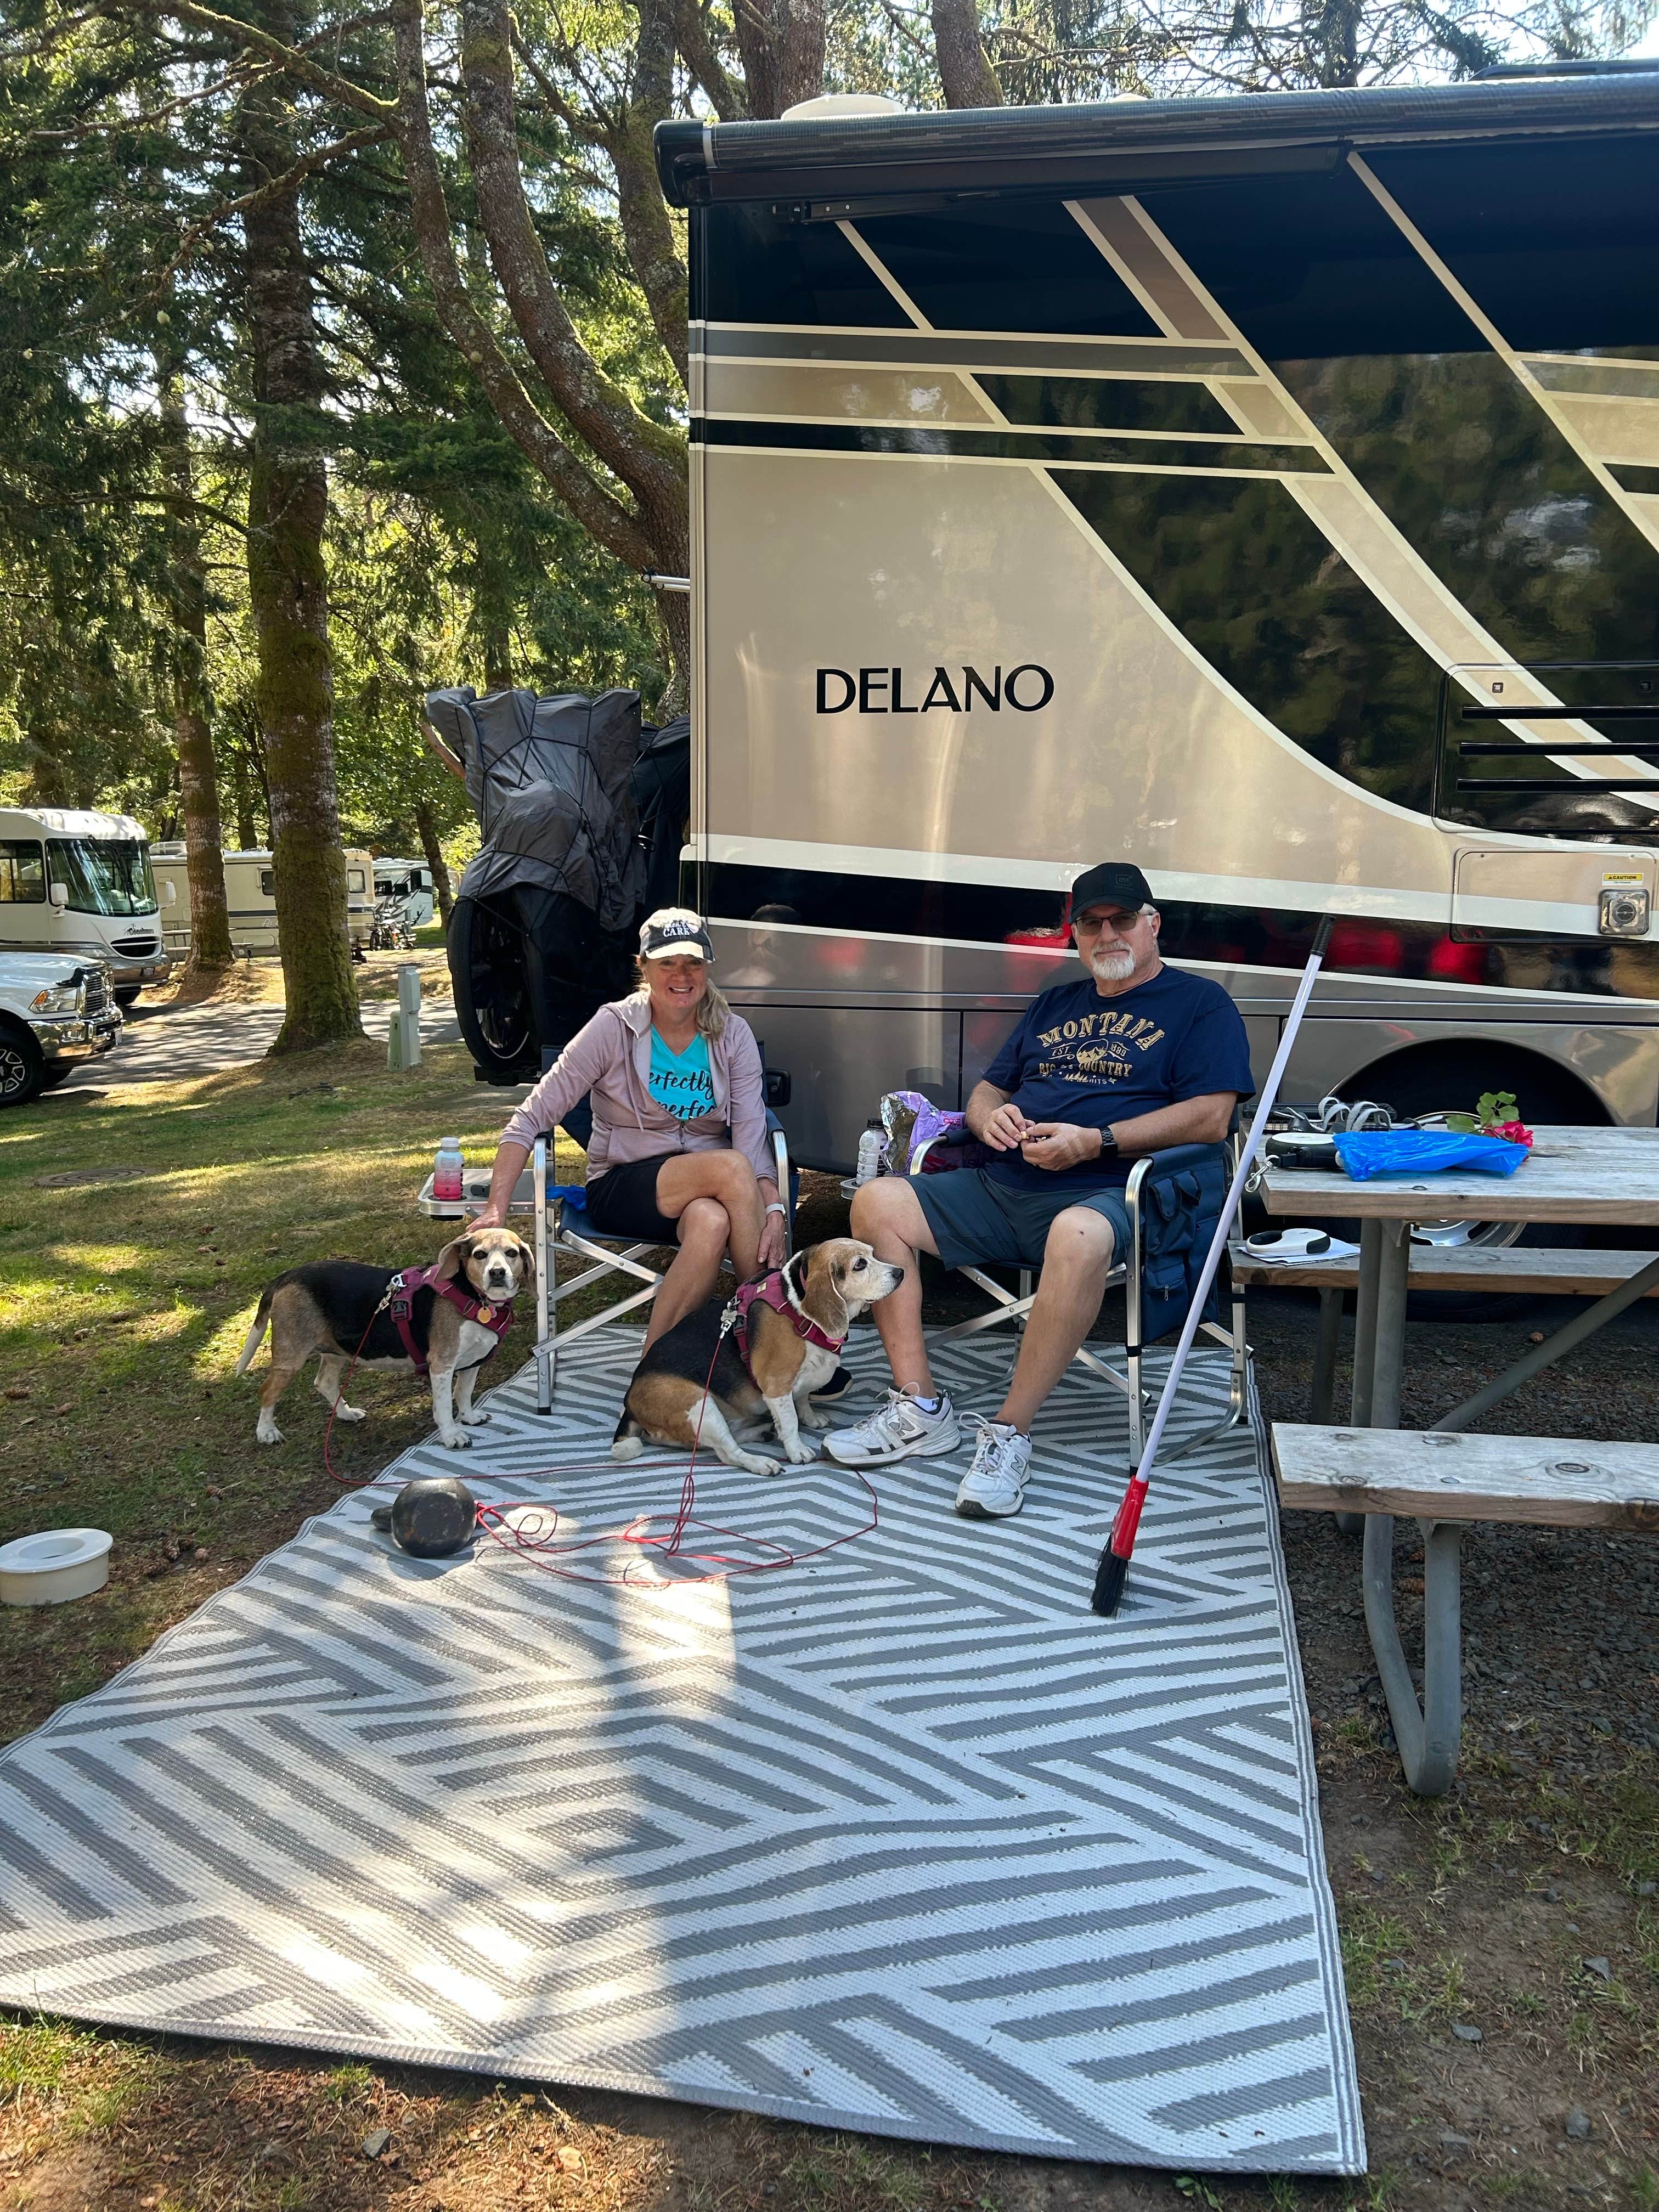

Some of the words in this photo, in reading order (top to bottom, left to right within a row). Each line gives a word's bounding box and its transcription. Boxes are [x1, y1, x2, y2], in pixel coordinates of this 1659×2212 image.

[816, 664, 1054, 713] DELANO
[663, 927, 690, 937] CARE
[1036, 1012, 1165, 1051] MONTANA
[1079, 1060, 1133, 1077] COUNTRY
[650, 1070, 713, 1101] erfectly
